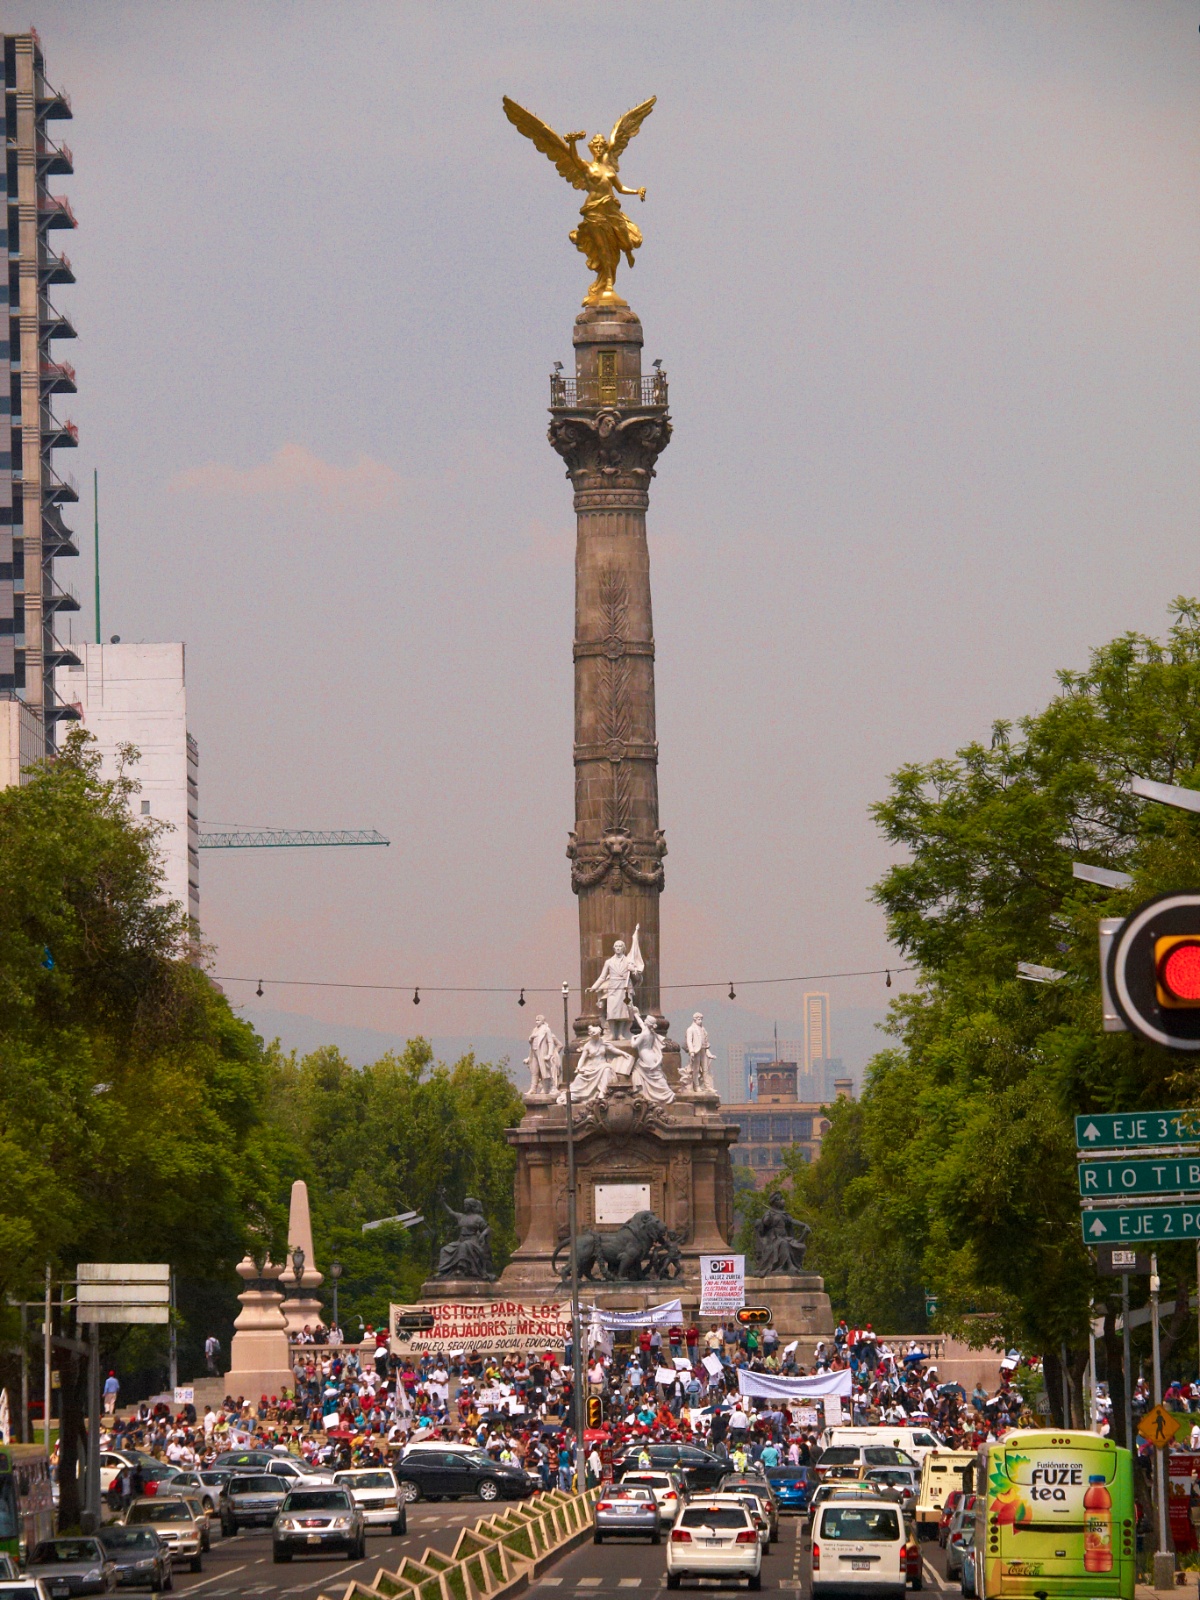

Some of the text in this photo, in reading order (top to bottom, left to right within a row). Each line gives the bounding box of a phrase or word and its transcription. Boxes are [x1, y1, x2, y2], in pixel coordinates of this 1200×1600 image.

[1113, 1119, 1148, 1140] EJE
[1157, 1118, 1169, 1138] 3
[1084, 1168, 1137, 1189] RIO
[1119, 1214, 1154, 1236] EJE
[1162, 1213, 1174, 1234] 2
[711, 1261, 733, 1272] OPT
[490, 1302, 525, 1318] PARA
[531, 1303, 561, 1319] LOS
[410, 1341, 445, 1352] EMPLEO,
[447, 1339, 494, 1351] SEGURIDAD
[494, 1337, 521, 1349] SOCIAL
[524, 1337, 564, 1349] EDUCACIO
[1036, 1461, 1069, 1469] Fusiónate
[1031, 1469, 1083, 1486] FUZE
[1030, 1486, 1067, 1502] tea
